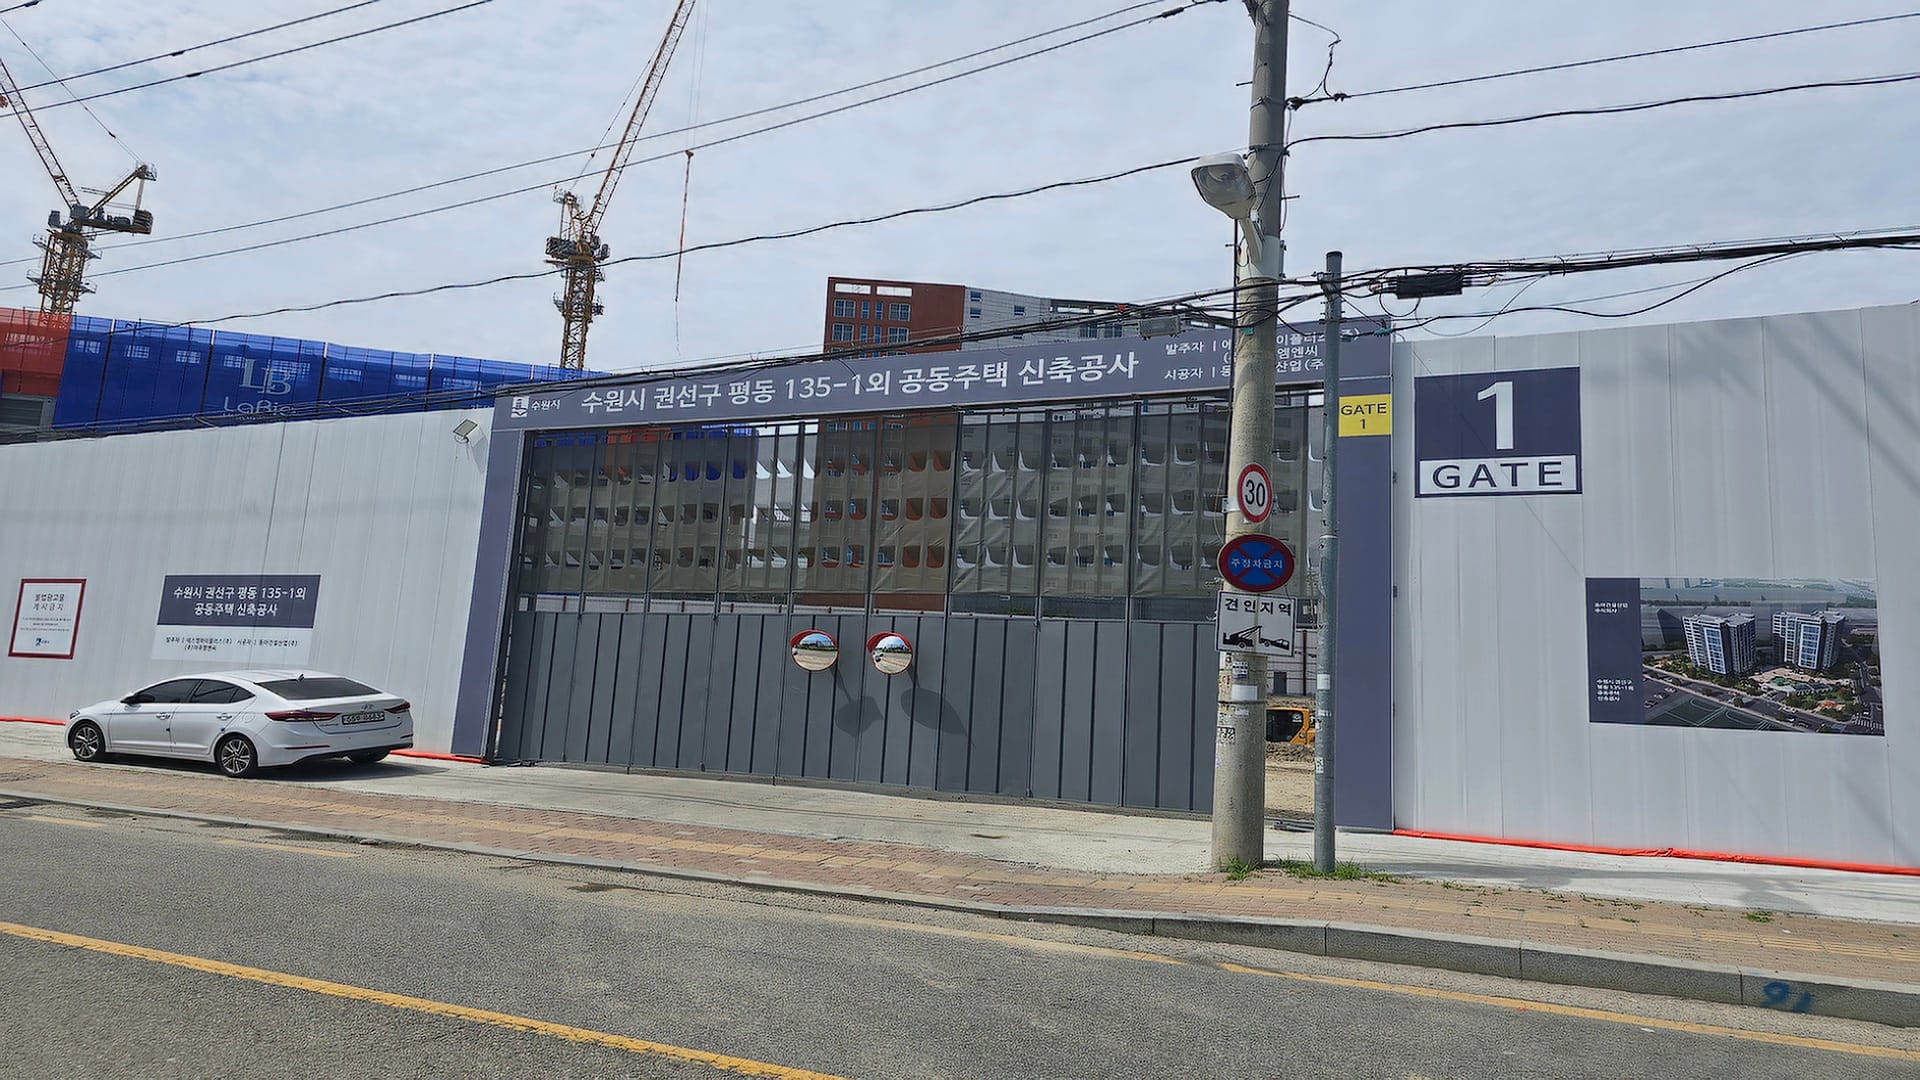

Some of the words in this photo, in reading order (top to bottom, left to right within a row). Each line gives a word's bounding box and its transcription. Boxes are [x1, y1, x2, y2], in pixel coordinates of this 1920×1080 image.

[1166, 341, 1204, 356] 발주자
[1164, 367, 1204, 381] 시공자
[531, 399, 560, 411] 수원시
[581, 387, 646, 414] 수원시
[653, 384, 722, 409] 권선구
[728, 379, 776, 405] 평동
[785, 370, 891, 400] 135-1외
[899, 361, 1009, 393] 공동주택
[1018, 351, 1140, 386] 신축공사
[1341, 403, 1387, 416] GATE
[1477, 381, 1514, 450] 1
[1360, 418, 1367, 430] 1
[1432, 461, 1563, 489] GATE
[1244, 479, 1266, 507] 30
[1231, 558, 1283, 569] 주정차금지
[173, 586, 203, 600] 수원시
[205, 586, 235, 600] 권선구
[237, 586, 257, 600] 평동
[261, 586, 307, 600] 135-1외
[194, 602, 235, 616] 공동주택
[236, 602, 278, 616] 신축공사
[1225, 597, 1292, 616] 견인지역
